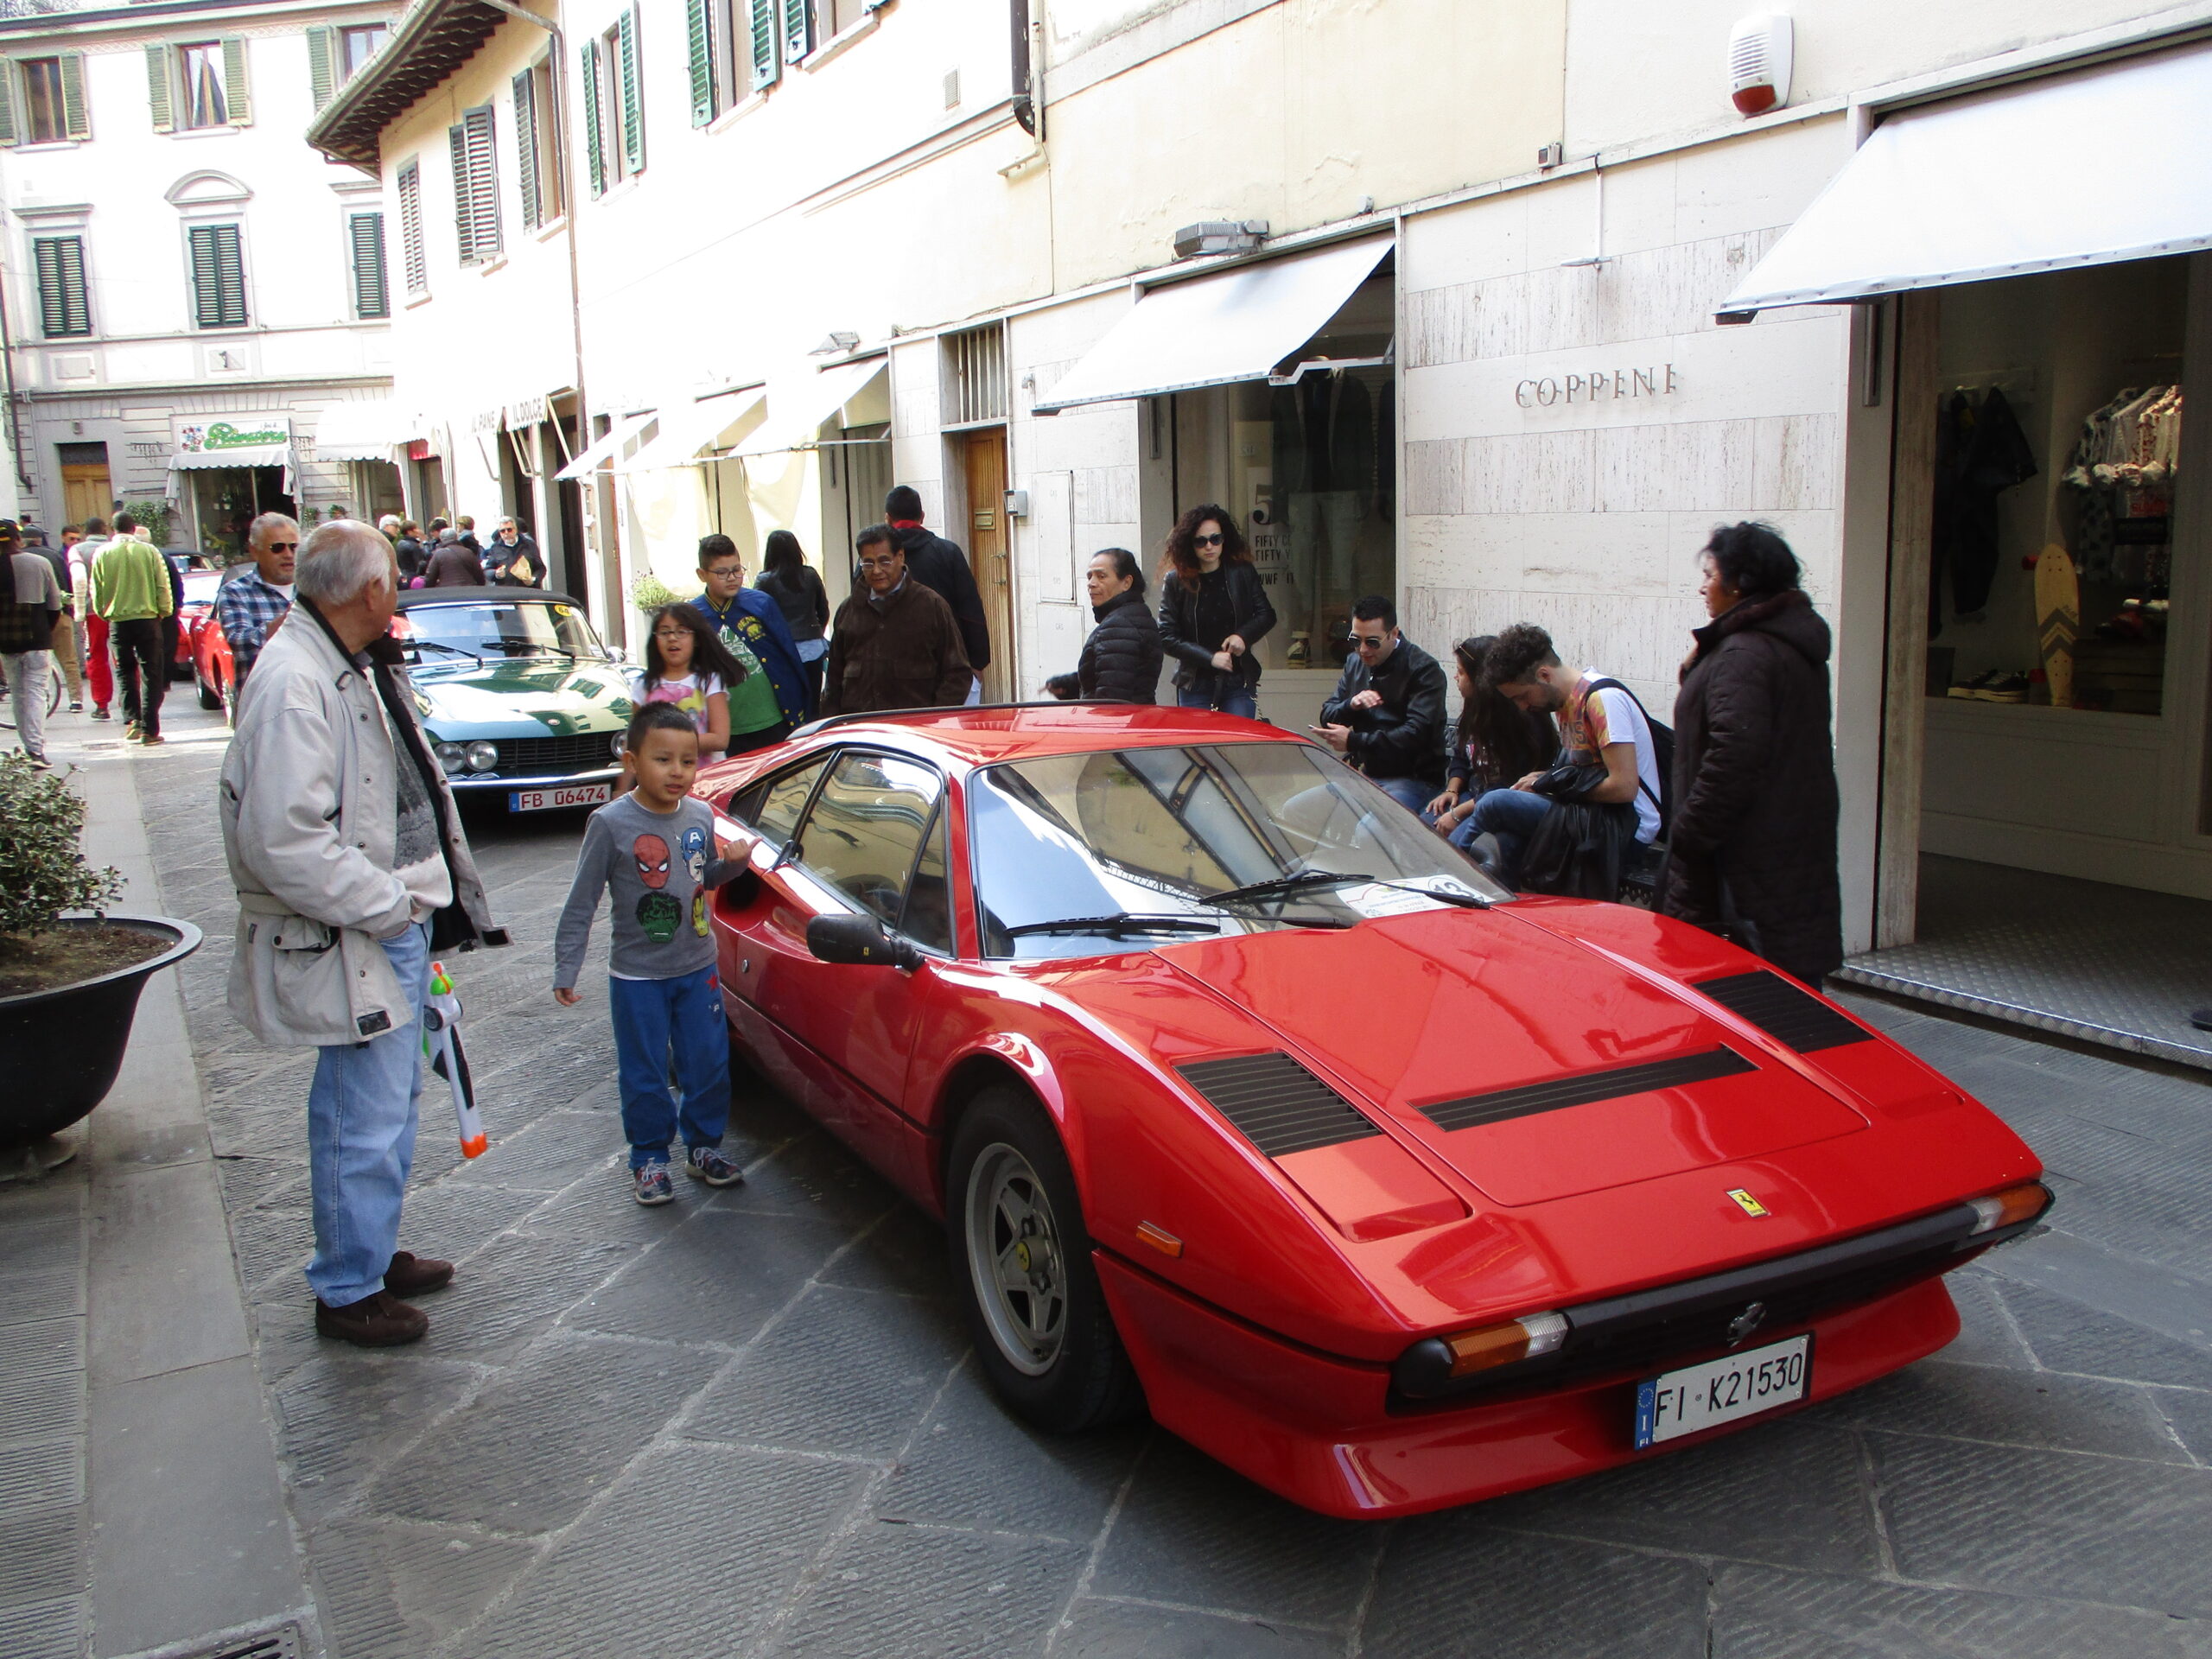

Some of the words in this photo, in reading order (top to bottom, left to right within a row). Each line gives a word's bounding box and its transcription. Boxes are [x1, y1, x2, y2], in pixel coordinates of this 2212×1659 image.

[1515, 363, 1675, 409] COPPINI
[520, 397, 543, 423] DOLCE
[1255, 534, 1280, 547] FIFTY
[1255, 549, 1281, 561] FIFTY
[521, 793, 543, 809] FB
[554, 787, 606, 805] 06474
[690, 831, 702, 843] A
[1655, 1385, 1685, 1427] FI
[1707, 1352, 1803, 1412] K21530
[1642, 1414, 1647, 1432] I
[1639, 1437, 1649, 1447] FI
